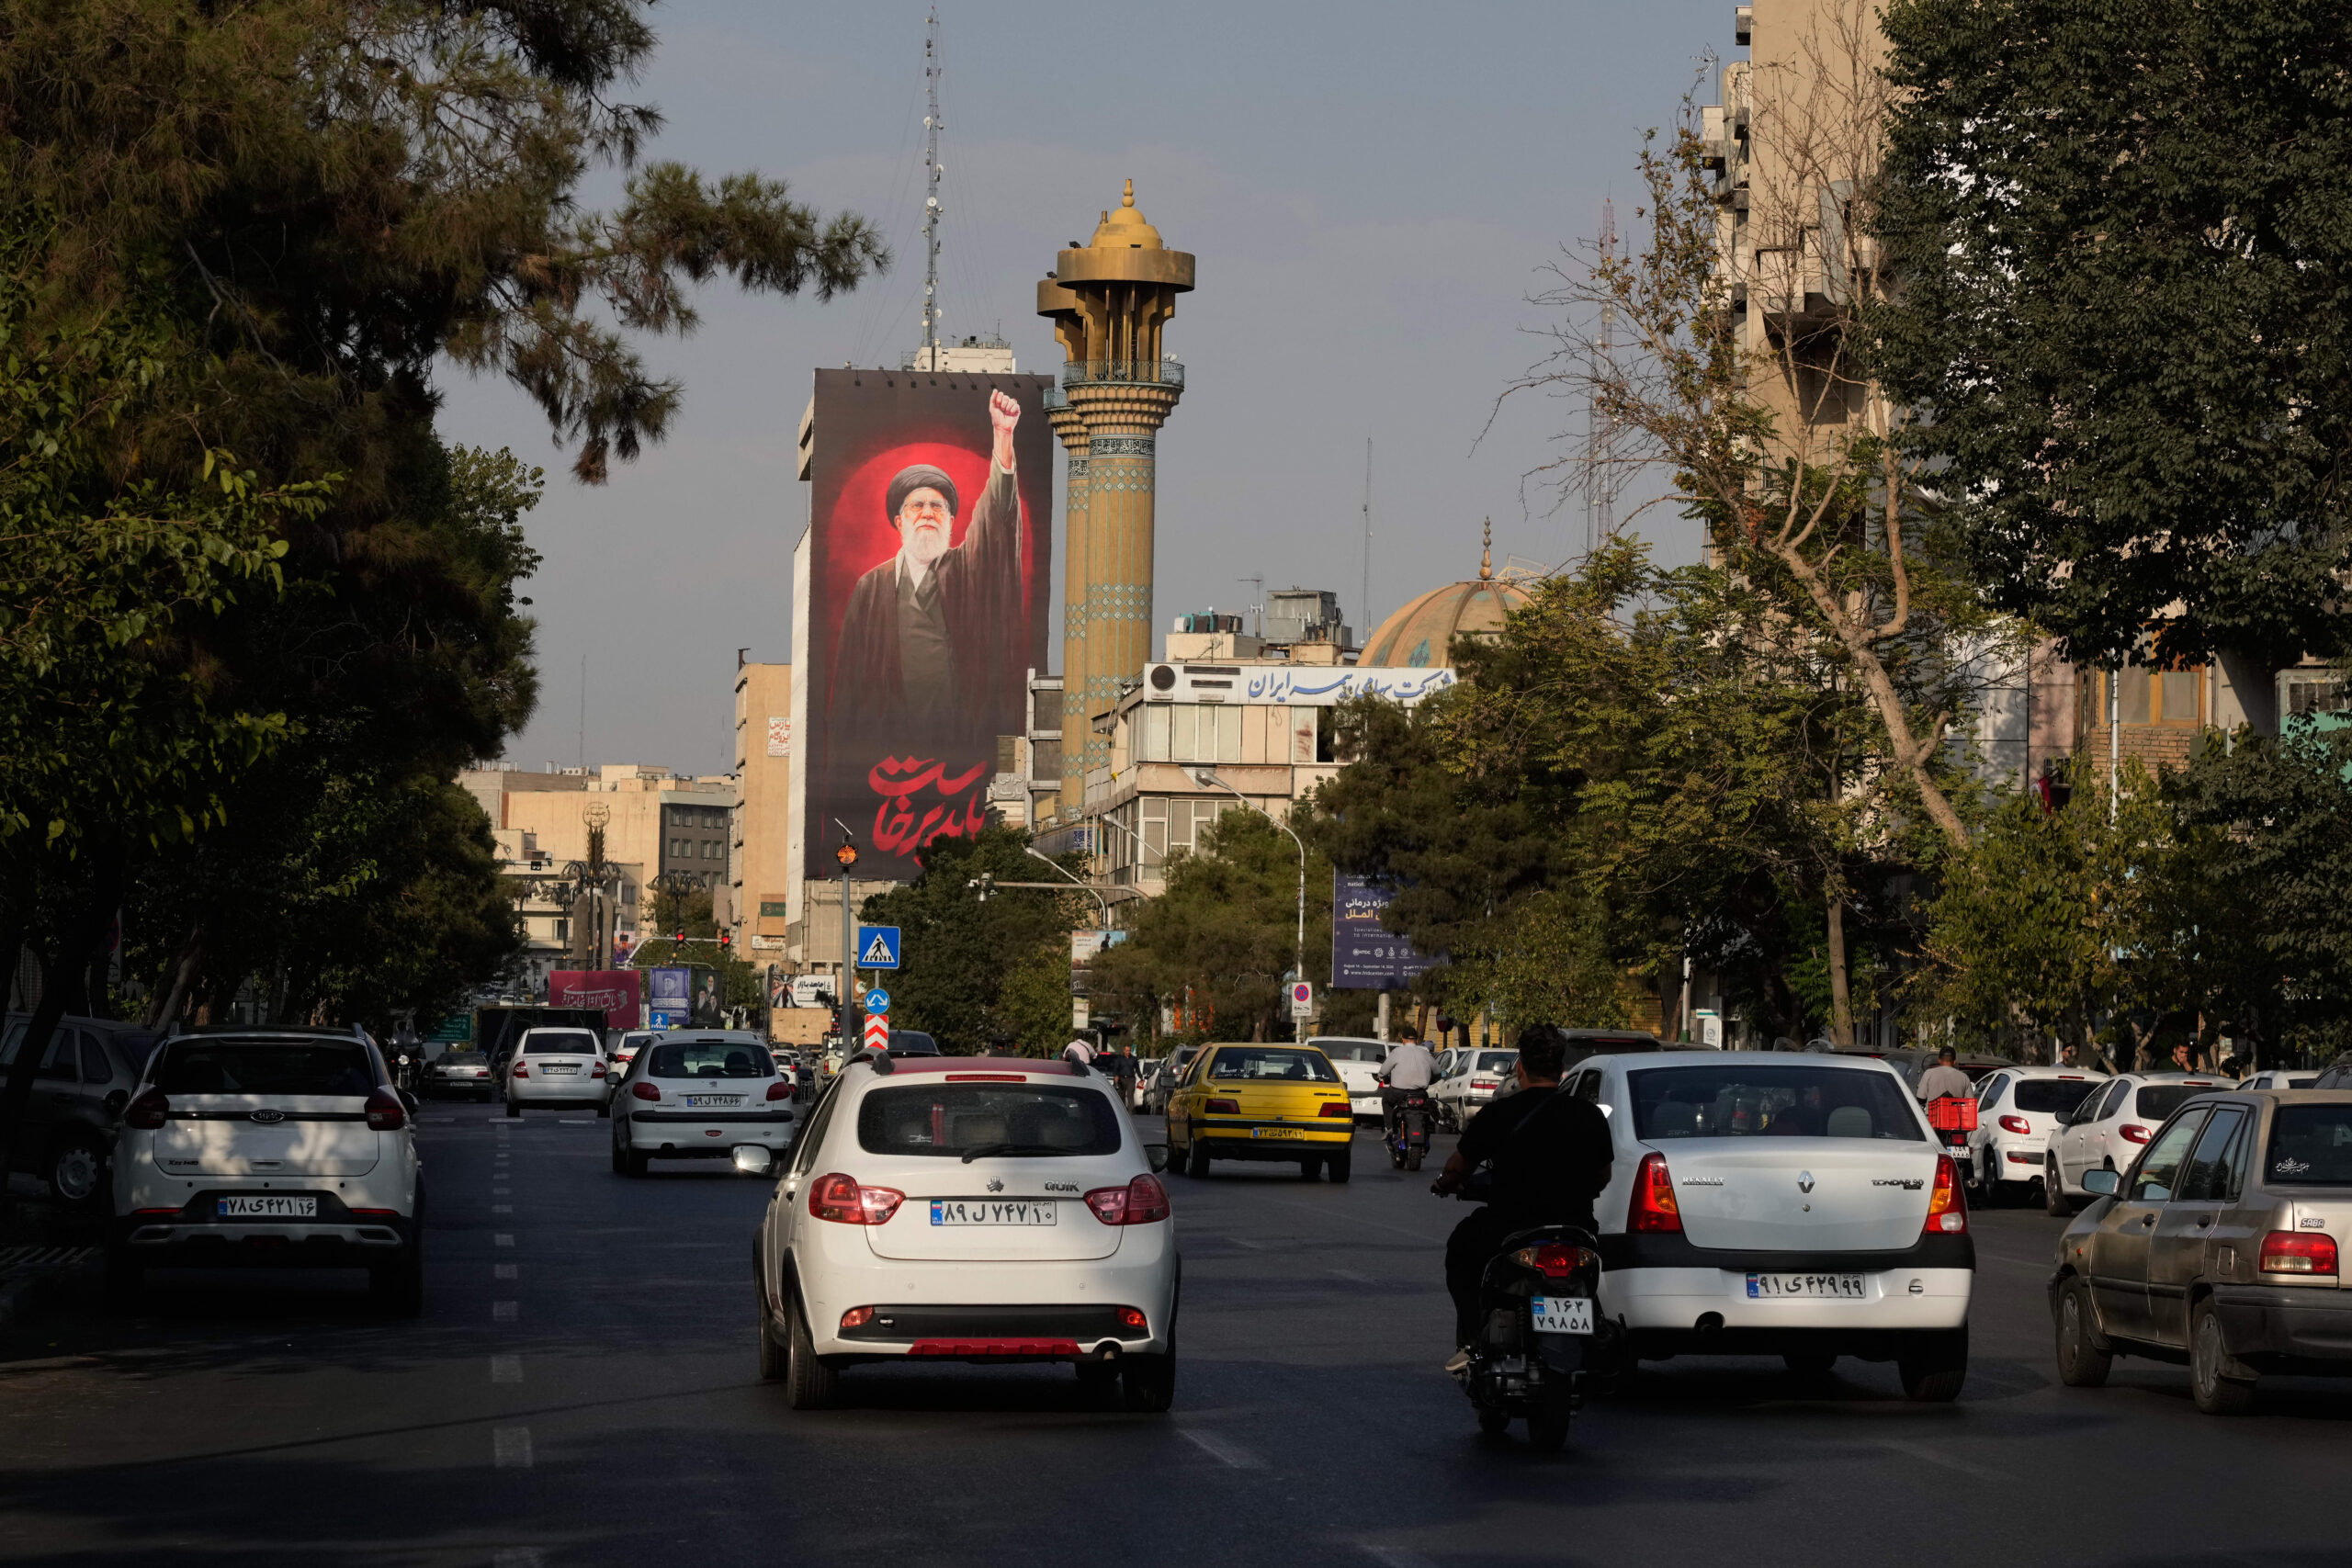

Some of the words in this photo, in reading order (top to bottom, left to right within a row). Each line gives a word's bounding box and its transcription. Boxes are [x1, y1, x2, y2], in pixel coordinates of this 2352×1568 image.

[1248, 671, 1291, 703] ایران
[1394, 670, 1452, 698] شکت
[1345, 897, 1371, 908] درمانی
[1045, 1180, 1080, 1192] QUIK
[1682, 1177, 1724, 1185] RENAULT
[2301, 1218, 2325, 1228] SABA
[1555, 1300, 1584, 1314] ۱۶۳
[1537, 1316, 1589, 1331] ۷۹۸۵۸
